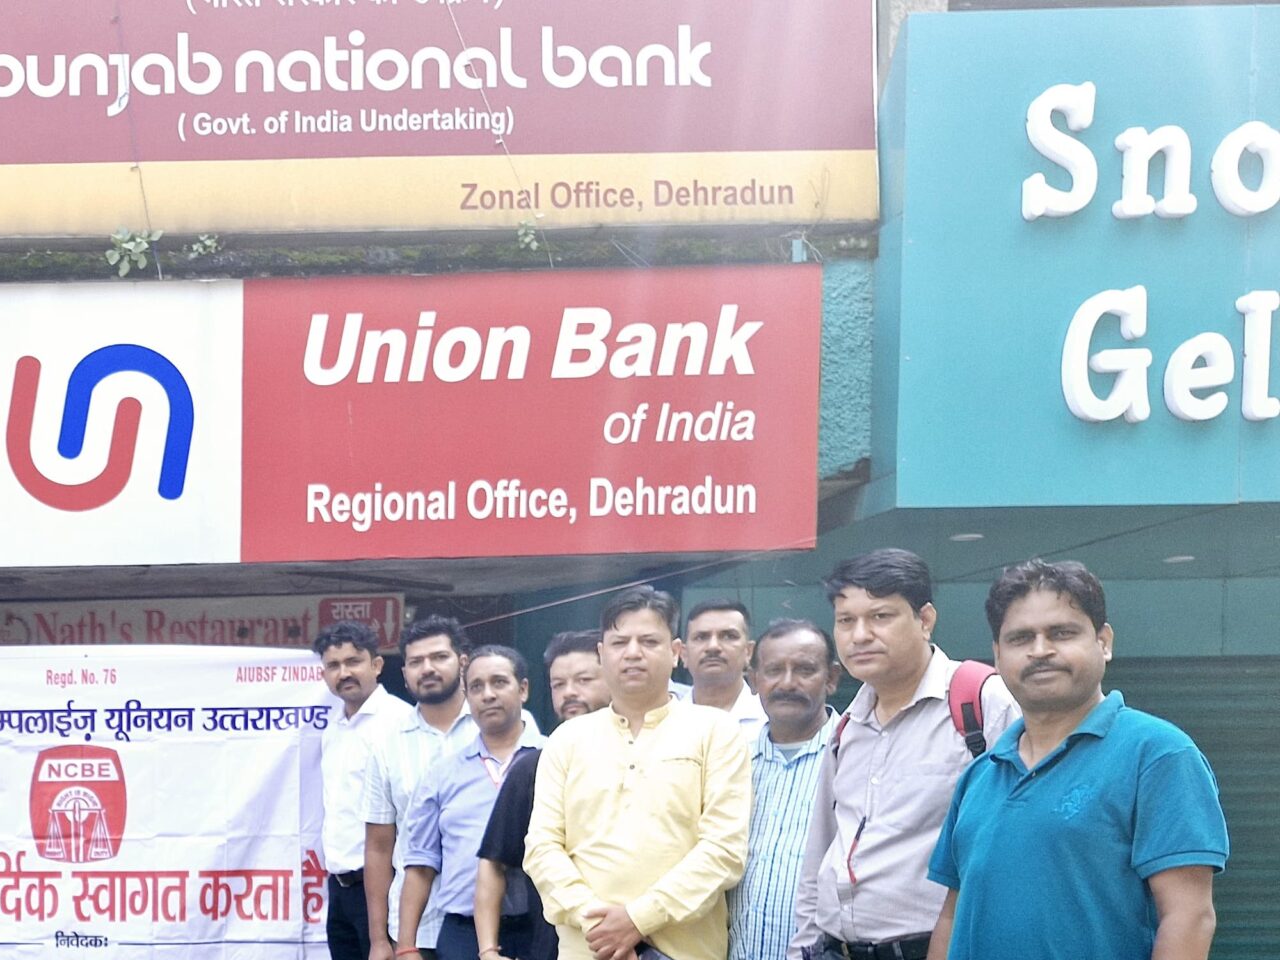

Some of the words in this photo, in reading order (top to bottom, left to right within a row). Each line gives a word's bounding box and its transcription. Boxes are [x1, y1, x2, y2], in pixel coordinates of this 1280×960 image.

[234, 27, 527, 94] national
[541, 25, 713, 88] bank
[264, 111, 289, 134] of
[294, 109, 352, 133] India
[360, 106, 515, 136] Undertaking)
[460, 183, 541, 211] Zonal
[550, 181, 644, 213] Office,
[653, 179, 795, 208] Dehradun
[302, 312, 531, 387] Union
[550, 304, 765, 380] Bank
[602, 405, 648, 445] of
[656, 404, 757, 443] India
[306, 483, 457, 531] Regional
[466, 479, 578, 525] Office,
[588, 476, 758, 518] Dehradun
[33, 609, 134, 645] Nath's
[143, 607, 312, 646] Restaurant
[331, 602, 372, 620] रास्ता
[46, 669, 78, 688] Regd.
[81, 669, 99, 685] No.
[103, 668, 118, 685] 76
[236, 666, 277, 683] AIUBSF
[281, 665, 324, 683] ZINDAB
[104, 699, 195, 742] यूनियन
[202, 705, 332, 732] उत्तराखण्ड
[48, 763, 111, 778] NCBE
[71, 870, 189, 923] स्वागत
[198, 870, 294, 922] करता
